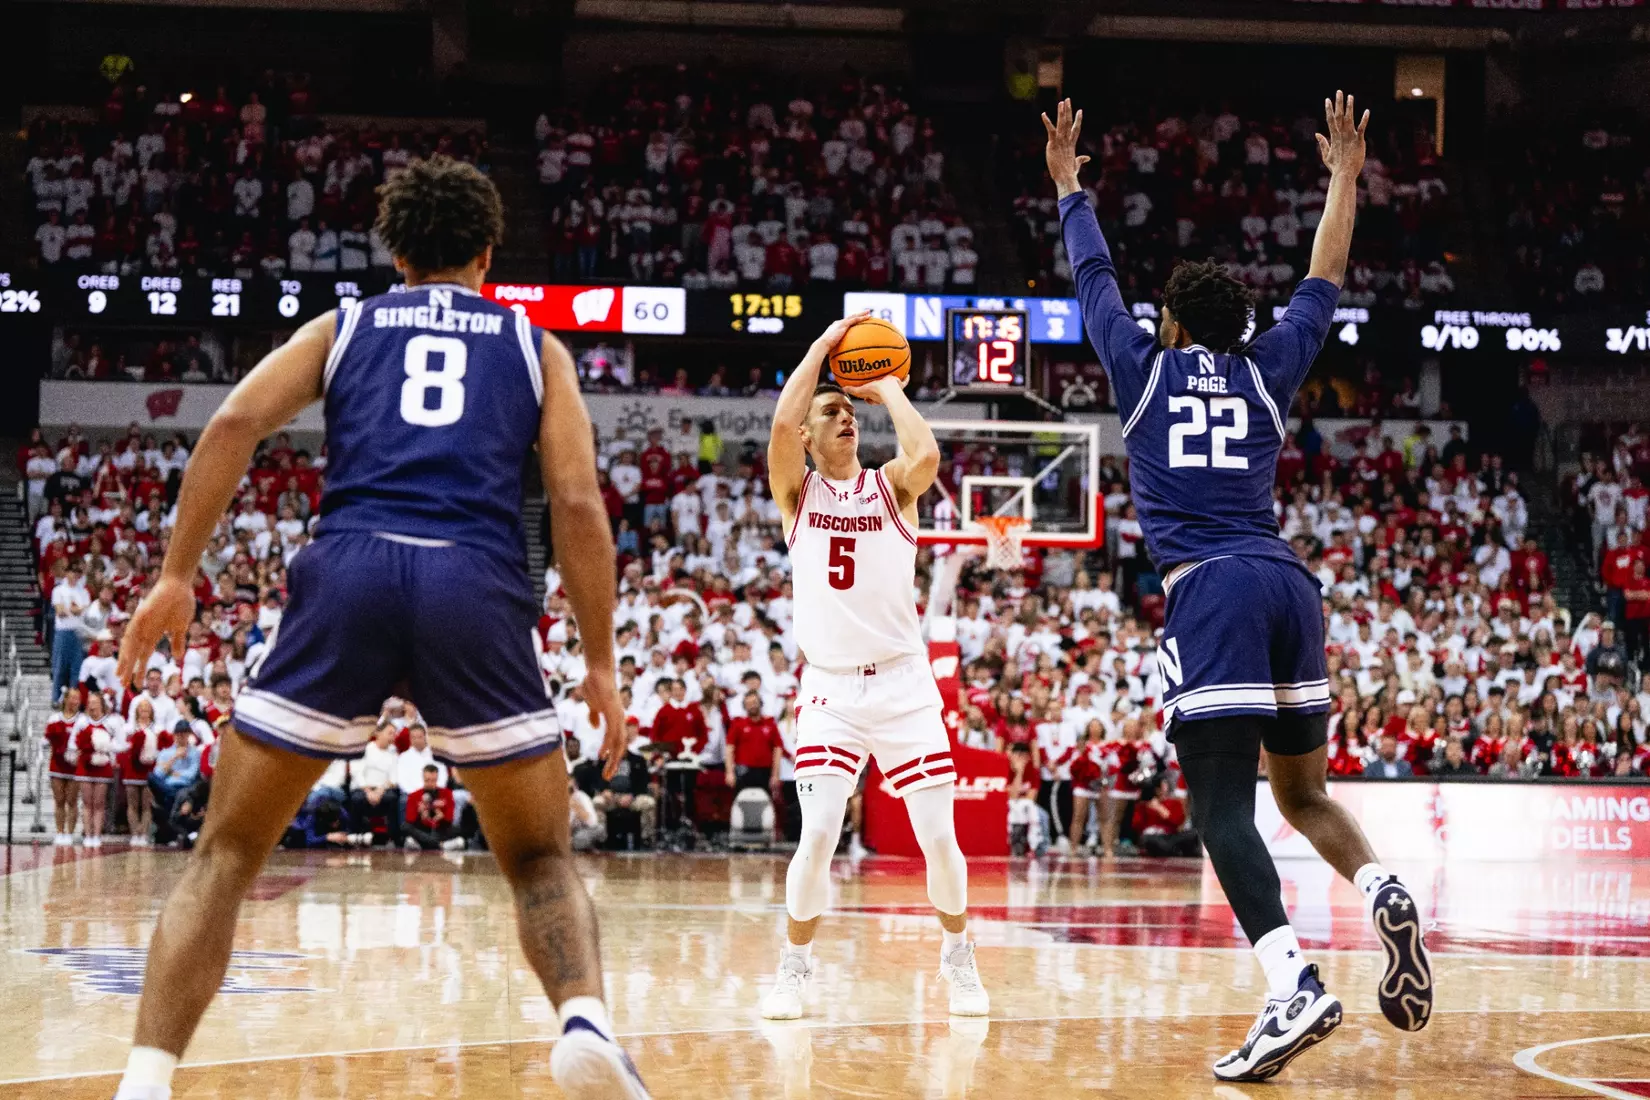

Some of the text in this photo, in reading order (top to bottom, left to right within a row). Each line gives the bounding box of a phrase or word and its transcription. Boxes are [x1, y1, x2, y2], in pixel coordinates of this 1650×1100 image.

[141, 276, 182, 292] DREB
[211, 278, 243, 293] REB
[279, 280, 301, 295] TO
[334, 282, 362, 297] STL
[494, 286, 544, 301] FOULS
[88, 291, 107, 314] 9
[148, 292, 177, 315] 12
[211, 294, 241, 317] 21
[278, 294, 300, 318] 0
[634, 302, 669, 321] 60
[730, 294, 802, 317] 17:15
[373, 305, 503, 335] SINGLETON
[1434, 310, 1532, 328] FREE THROWS
[1421, 325, 1562, 352] 9/10 90%
[838, 358, 892, 374] Wilson
[978, 341, 1015, 382] 12
[1199, 353, 1216, 374] N
[400, 334, 467, 427] 8
[1186, 375, 1228, 393] PAGE
[1168, 395, 1249, 469] 22
[808, 512, 883, 533] WISCONSIN
[828, 536, 857, 591] 5
[1553, 826, 1633, 851] DELLS
